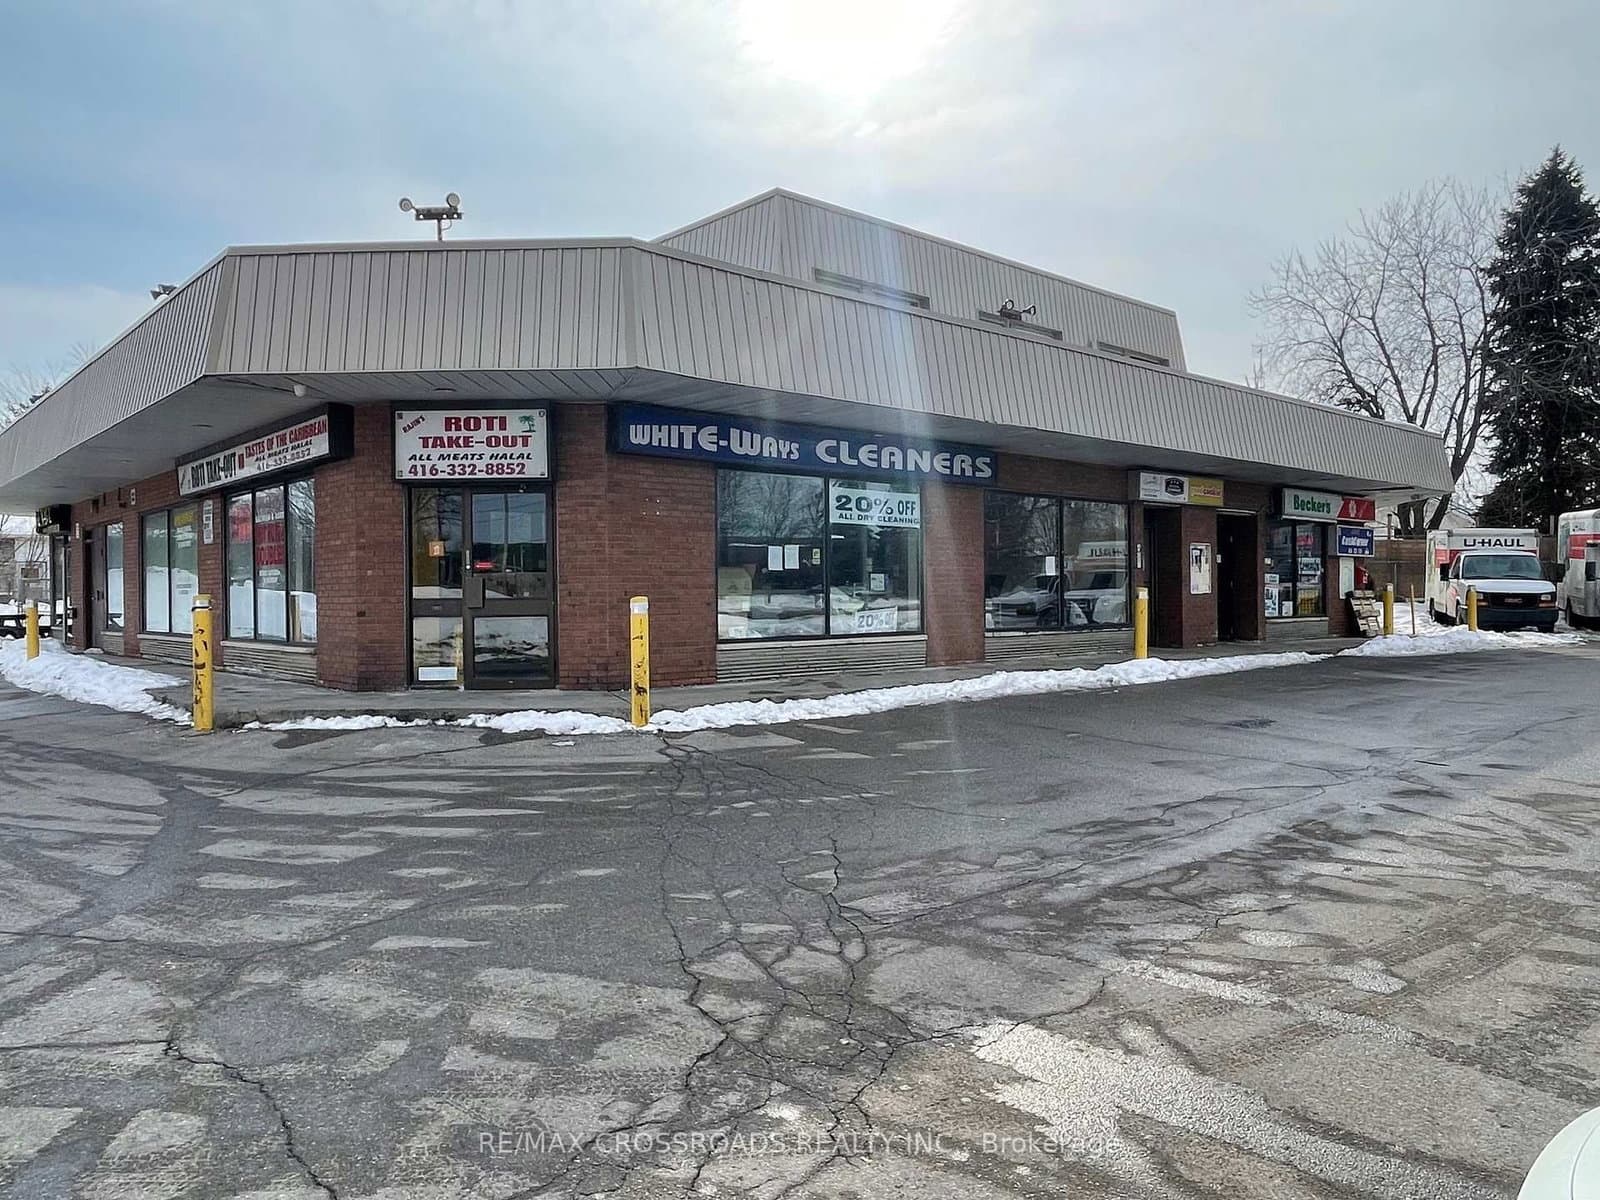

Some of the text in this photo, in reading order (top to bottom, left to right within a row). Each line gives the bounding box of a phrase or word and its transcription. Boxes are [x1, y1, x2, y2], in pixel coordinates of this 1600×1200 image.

[444, 416, 507, 432] ROTI
[418, 435, 533, 449] TAKE-OUT
[408, 452, 533, 461] ALL MEATS HALAL
[815, 439, 993, 478] CLEANERS
[408, 463, 526, 477] 416-332-8852
[835, 494, 916, 516] 20% OFF
